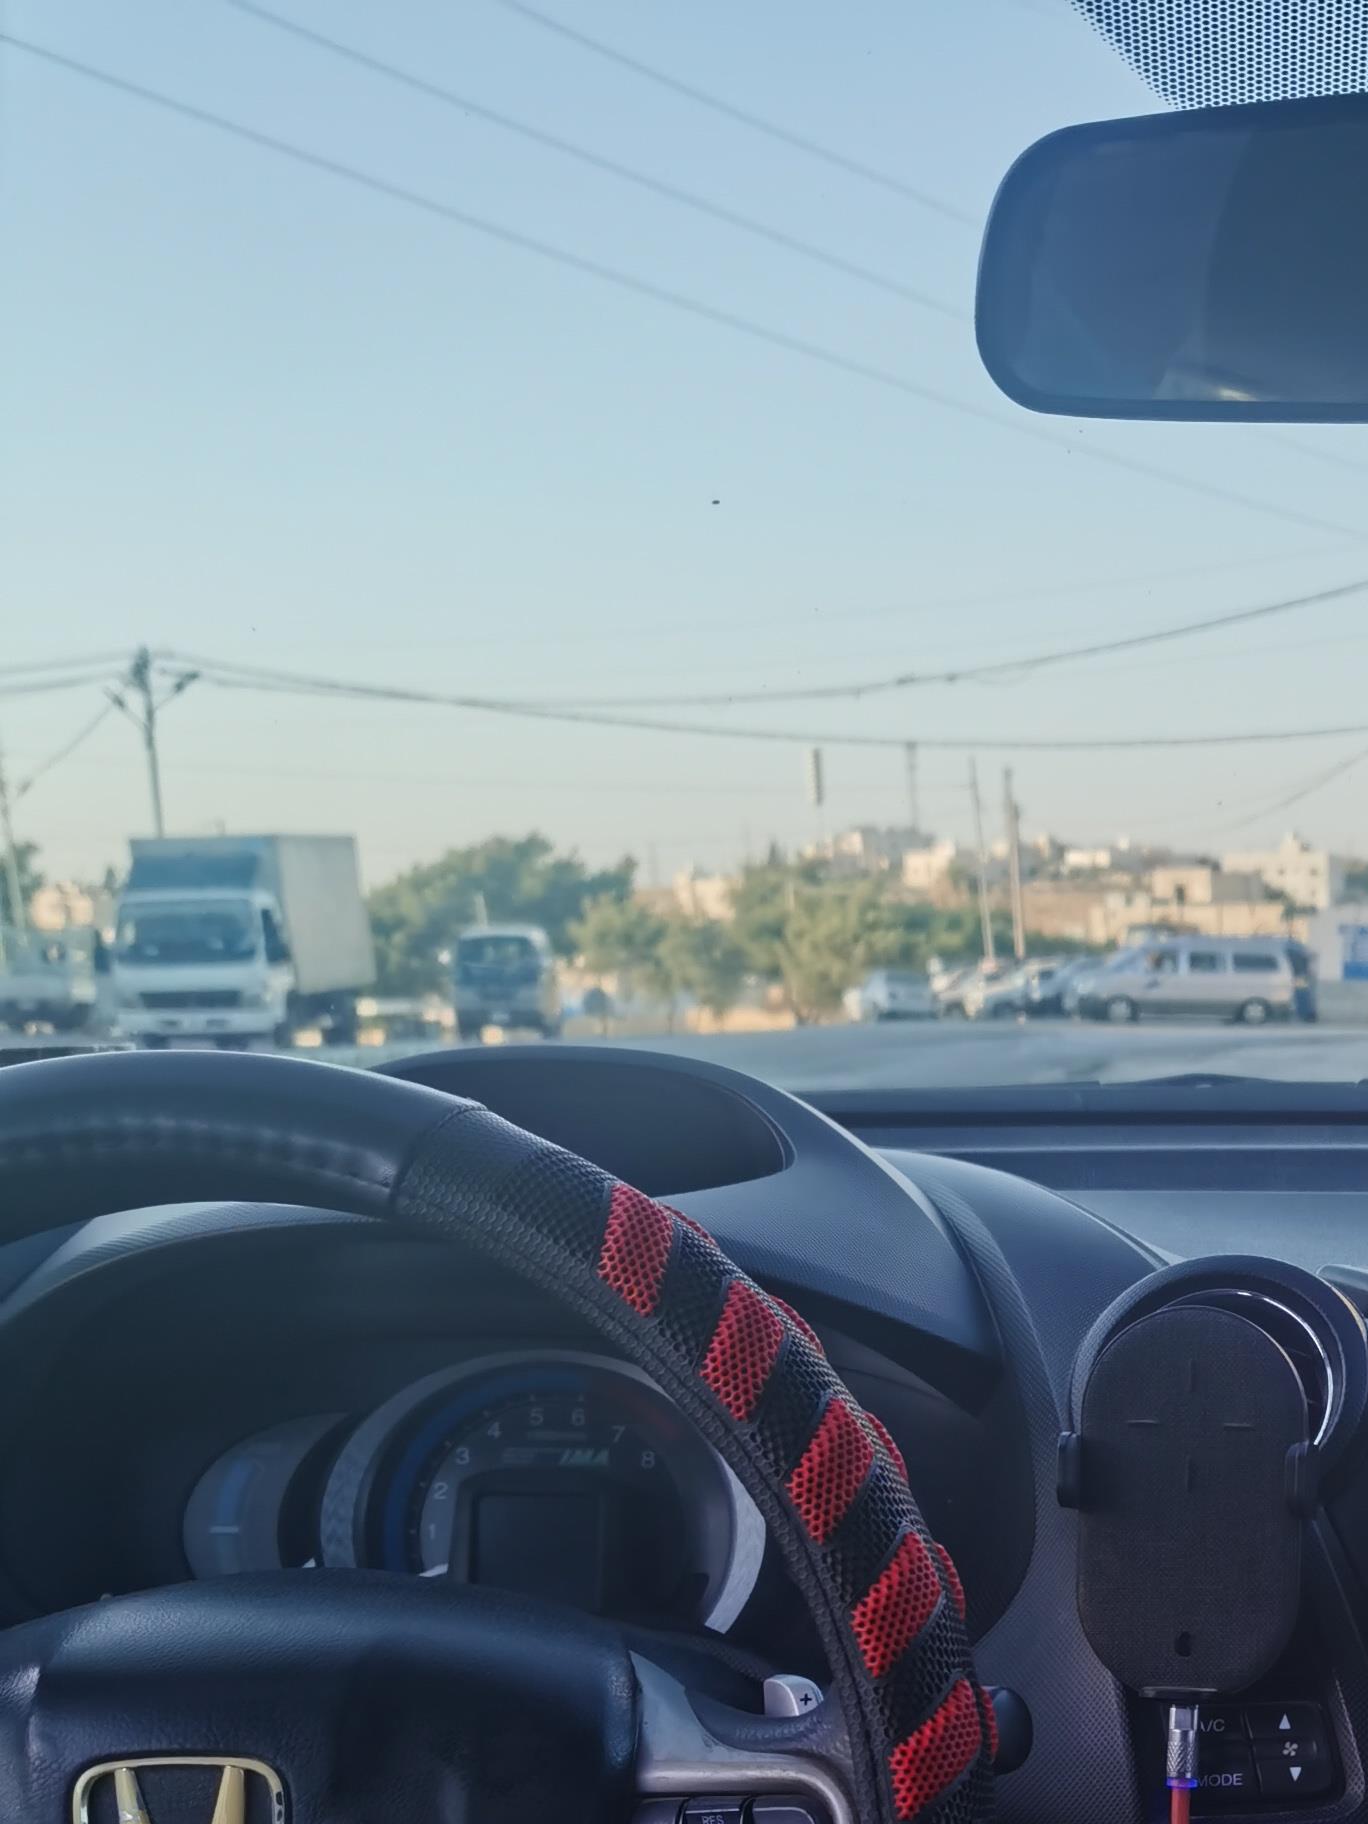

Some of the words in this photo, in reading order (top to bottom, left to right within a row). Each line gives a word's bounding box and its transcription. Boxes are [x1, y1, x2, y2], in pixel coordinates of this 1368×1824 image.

[530, 1408, 544, 1426] 5
[571, 1408, 586, 1427] 6
[487, 1422, 502, 1439] 4
[611, 1425, 626, 1444] 7
[455, 1447, 471, 1465] 3
[641, 1451, 656, 1469] 8
[433, 1482, 448, 1500] 2
[428, 1523, 436, 1540] 1
